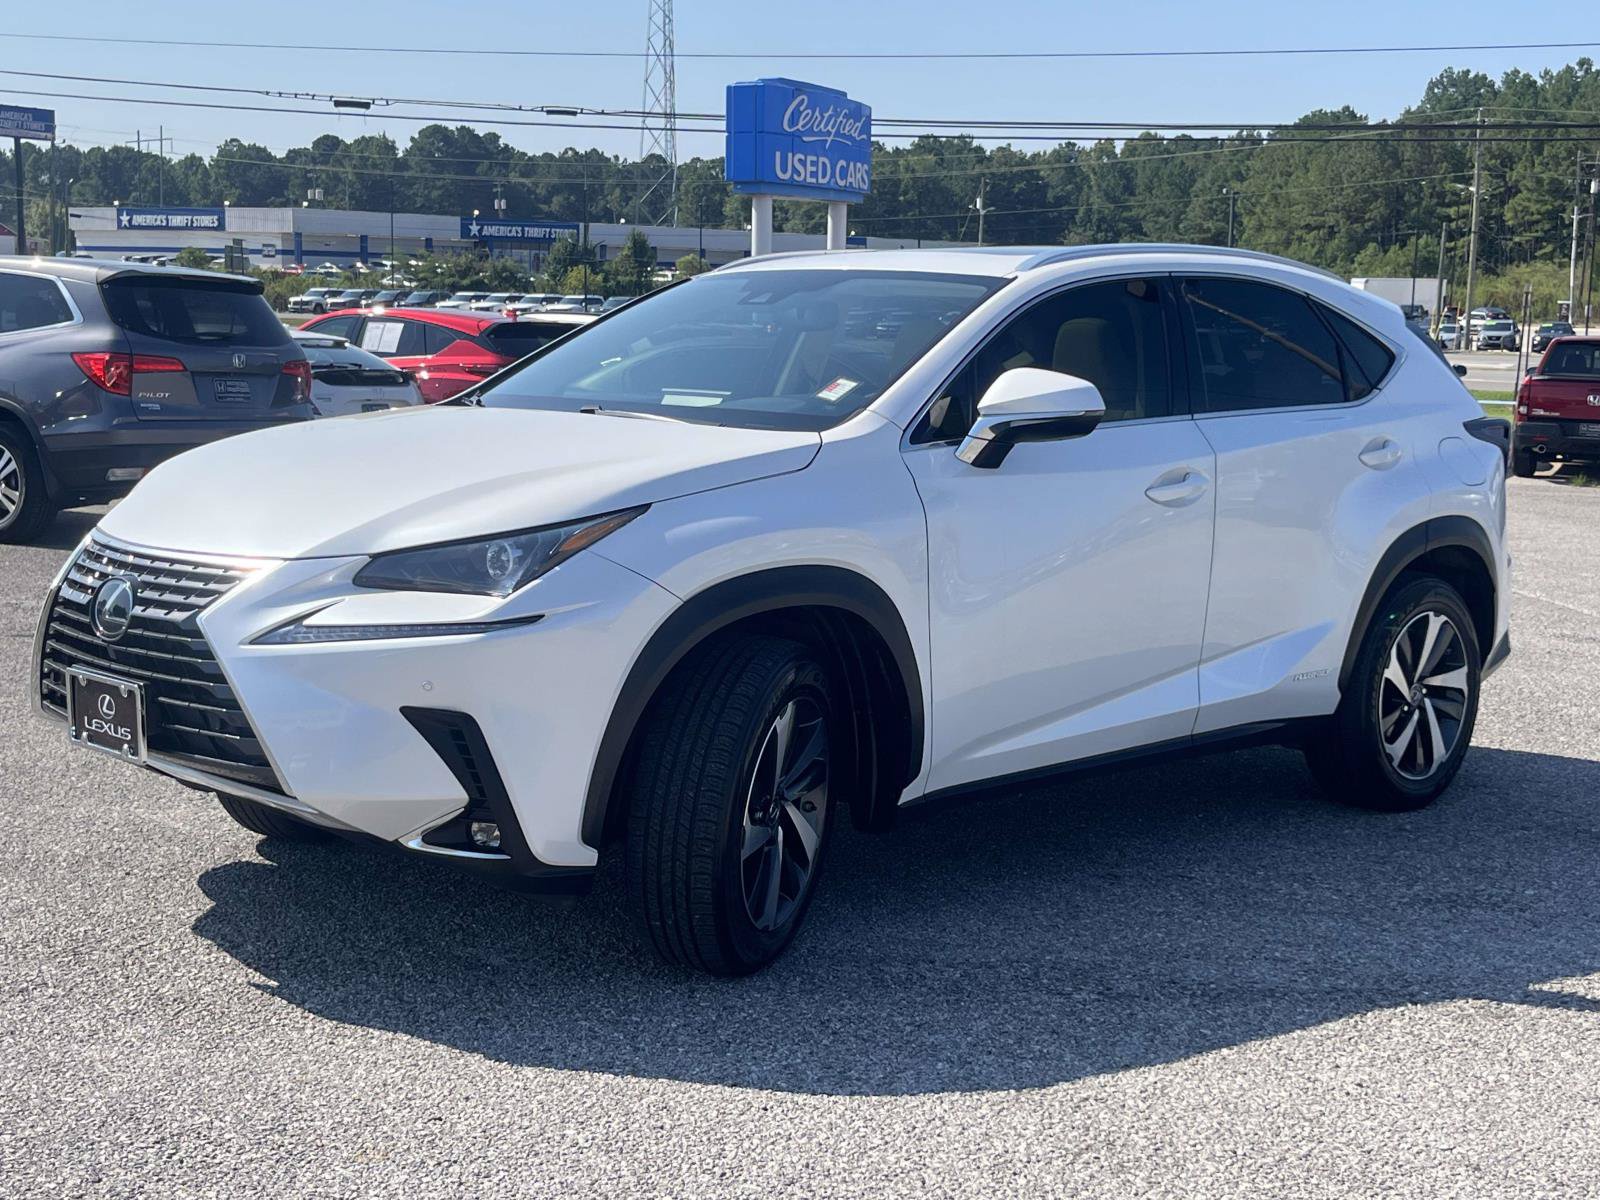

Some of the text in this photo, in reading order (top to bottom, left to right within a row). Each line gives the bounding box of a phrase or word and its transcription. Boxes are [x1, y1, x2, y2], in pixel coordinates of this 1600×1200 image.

[783, 95, 867, 149] Certified
[775, 151, 868, 190] USED CARS
[132, 215, 219, 227] AMERICA'S THRIFT STORES
[482, 225, 522, 237] AMERICA'S
[524, 226, 551, 238] THRIFT
[84, 716, 131, 740] LEXUS
